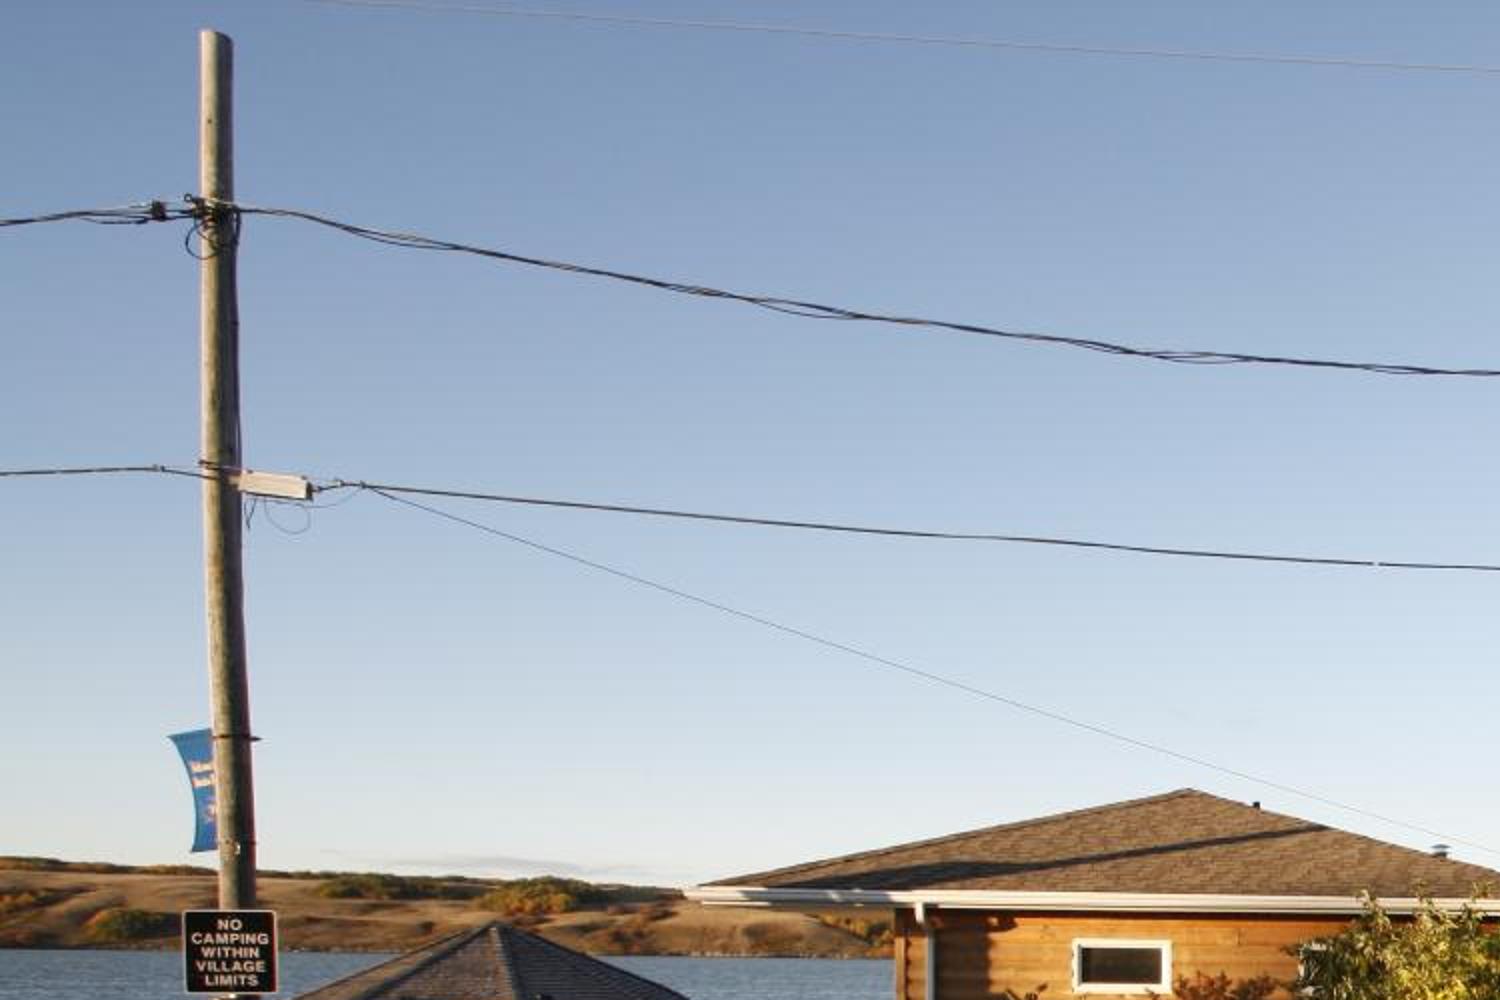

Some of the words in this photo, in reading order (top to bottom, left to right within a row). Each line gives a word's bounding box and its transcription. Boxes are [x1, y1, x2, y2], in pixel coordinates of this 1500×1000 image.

[217, 919, 243, 931] NO
[191, 932, 269, 945] CAMPING
[201, 947, 259, 958] WITHIN
[195, 961, 266, 972] VILLAGE
[205, 974, 259, 986] LIMITS
